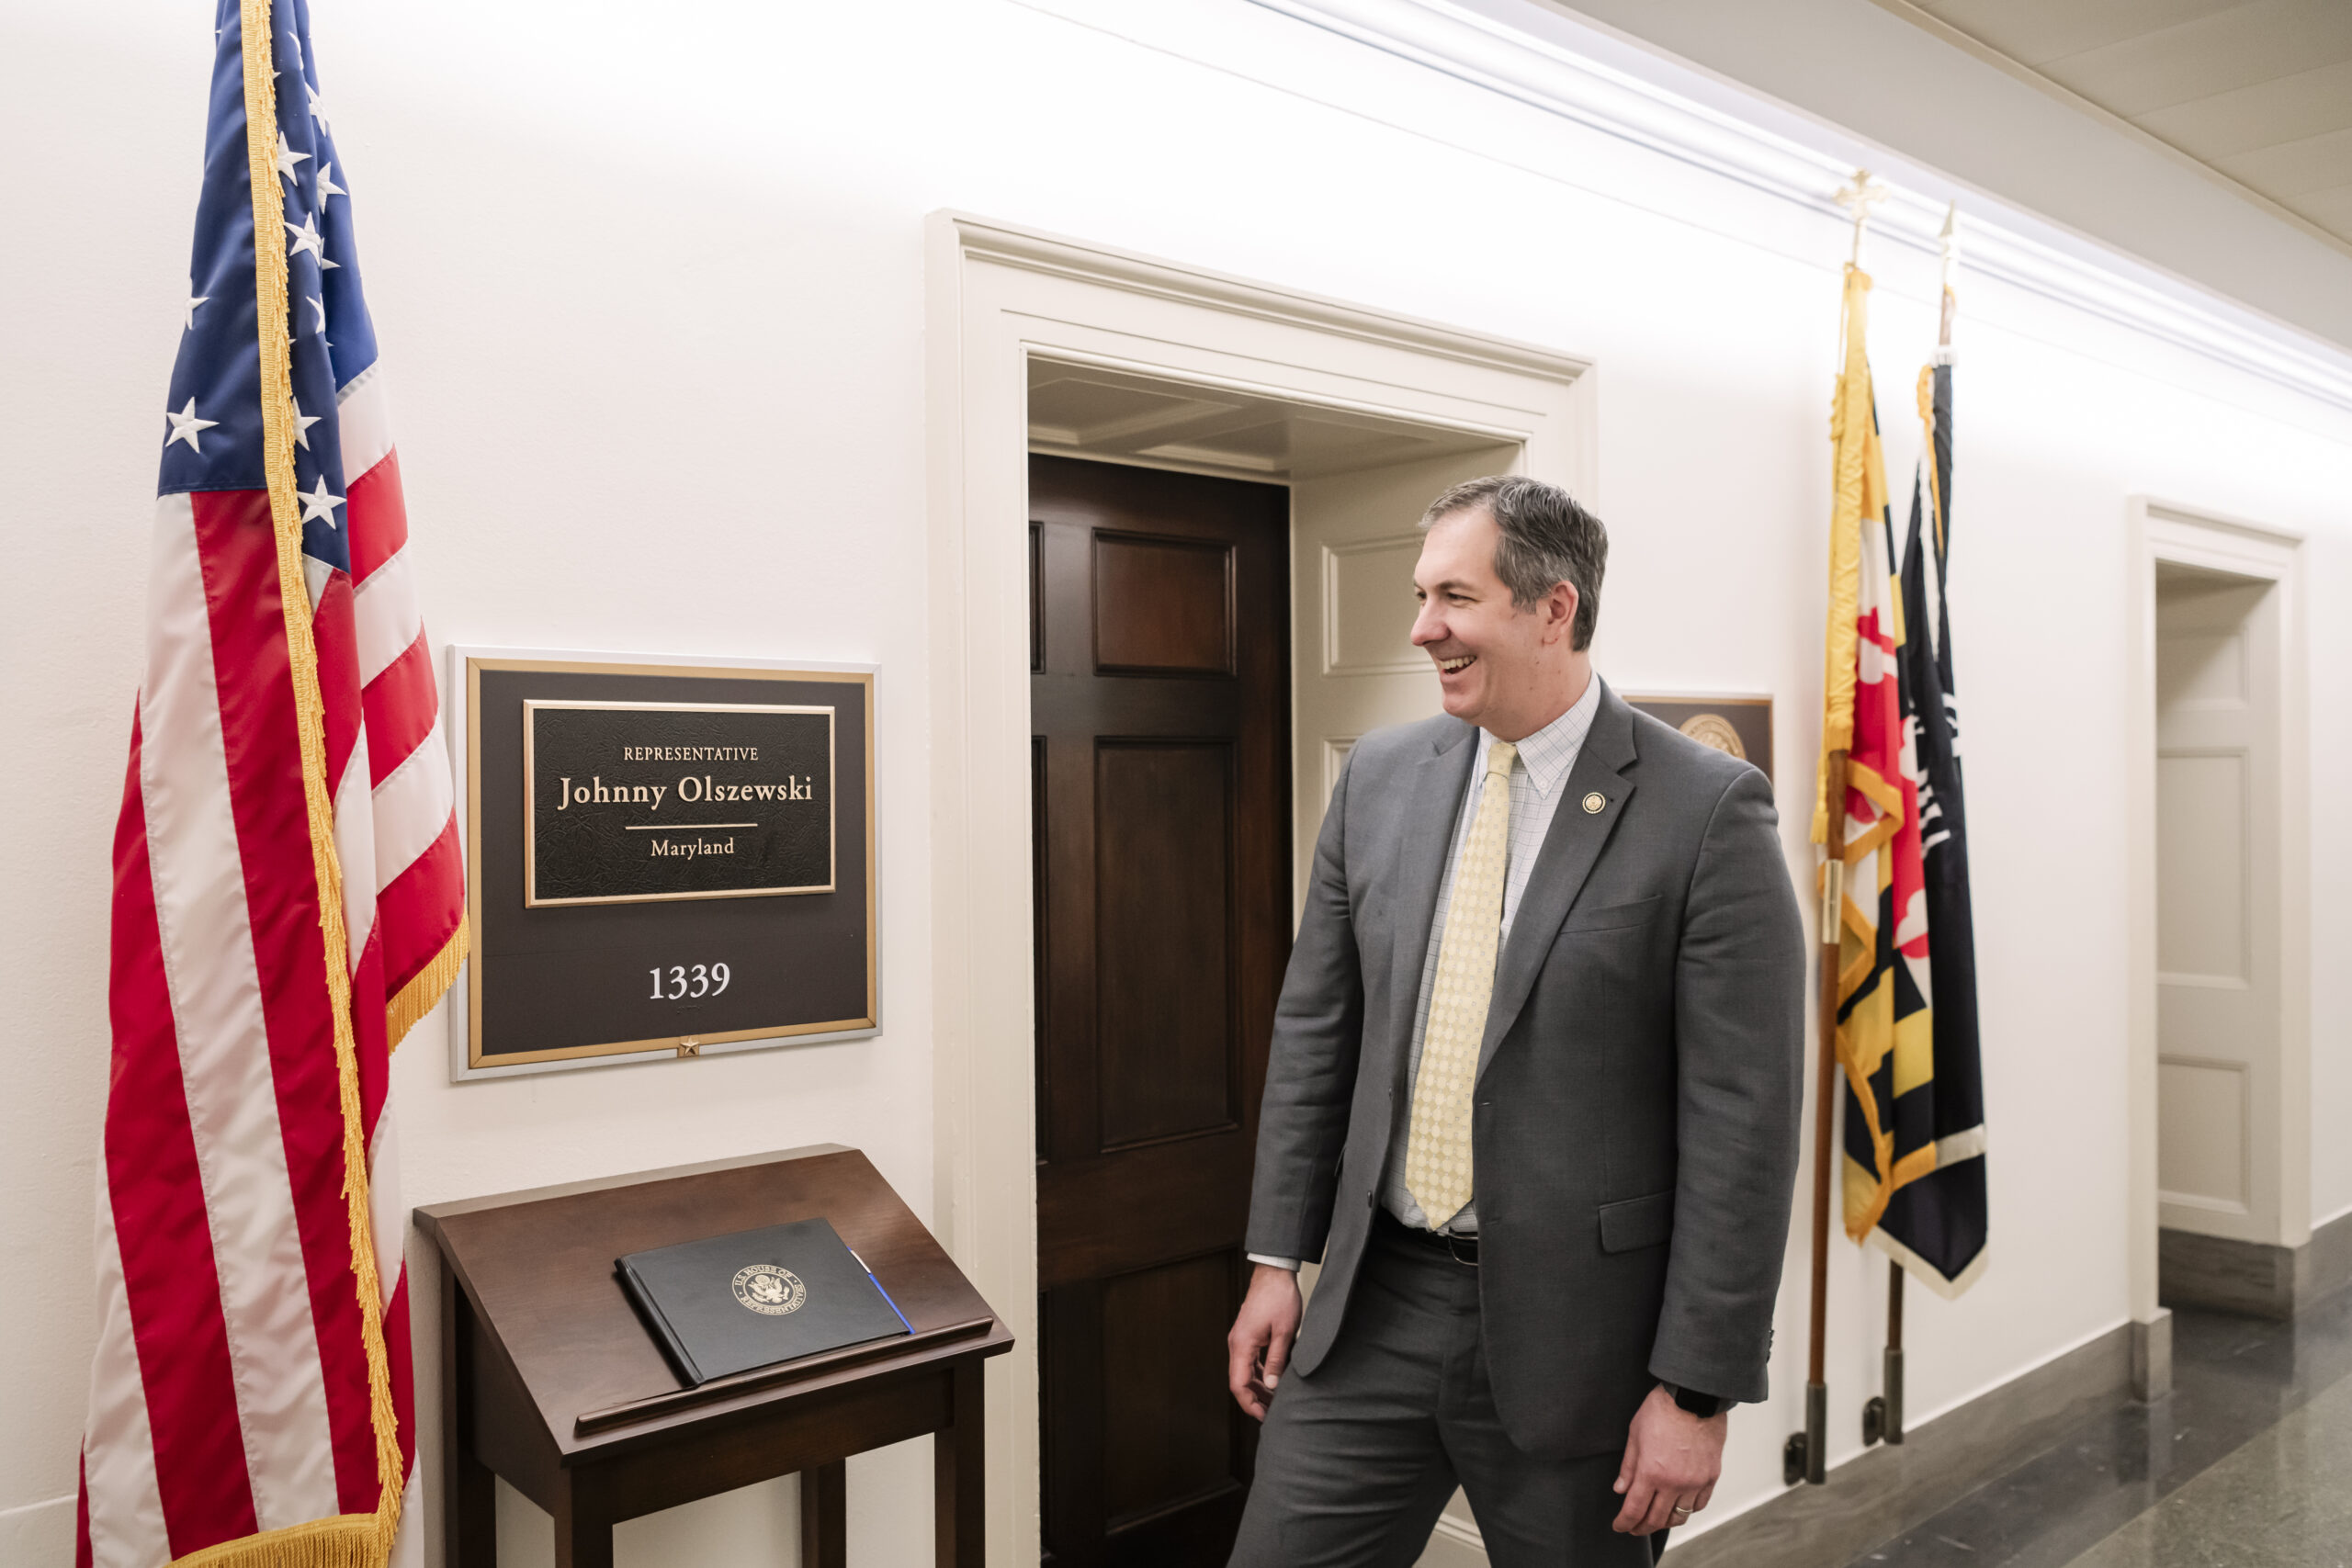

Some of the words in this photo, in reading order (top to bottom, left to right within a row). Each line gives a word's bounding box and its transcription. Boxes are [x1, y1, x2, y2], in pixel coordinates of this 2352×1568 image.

[624, 747, 759, 761] REPRESENTATIVE
[557, 776, 668, 811] Johnny
[678, 775, 813, 803] Olszewski
[650, 837, 735, 861] Maryland
[650, 962, 731, 1000] 1339
[743, 1267, 777, 1277] HOUSE
[778, 1269, 792, 1279] OF
[741, 1284, 804, 1314] REPRESENTATIVES
